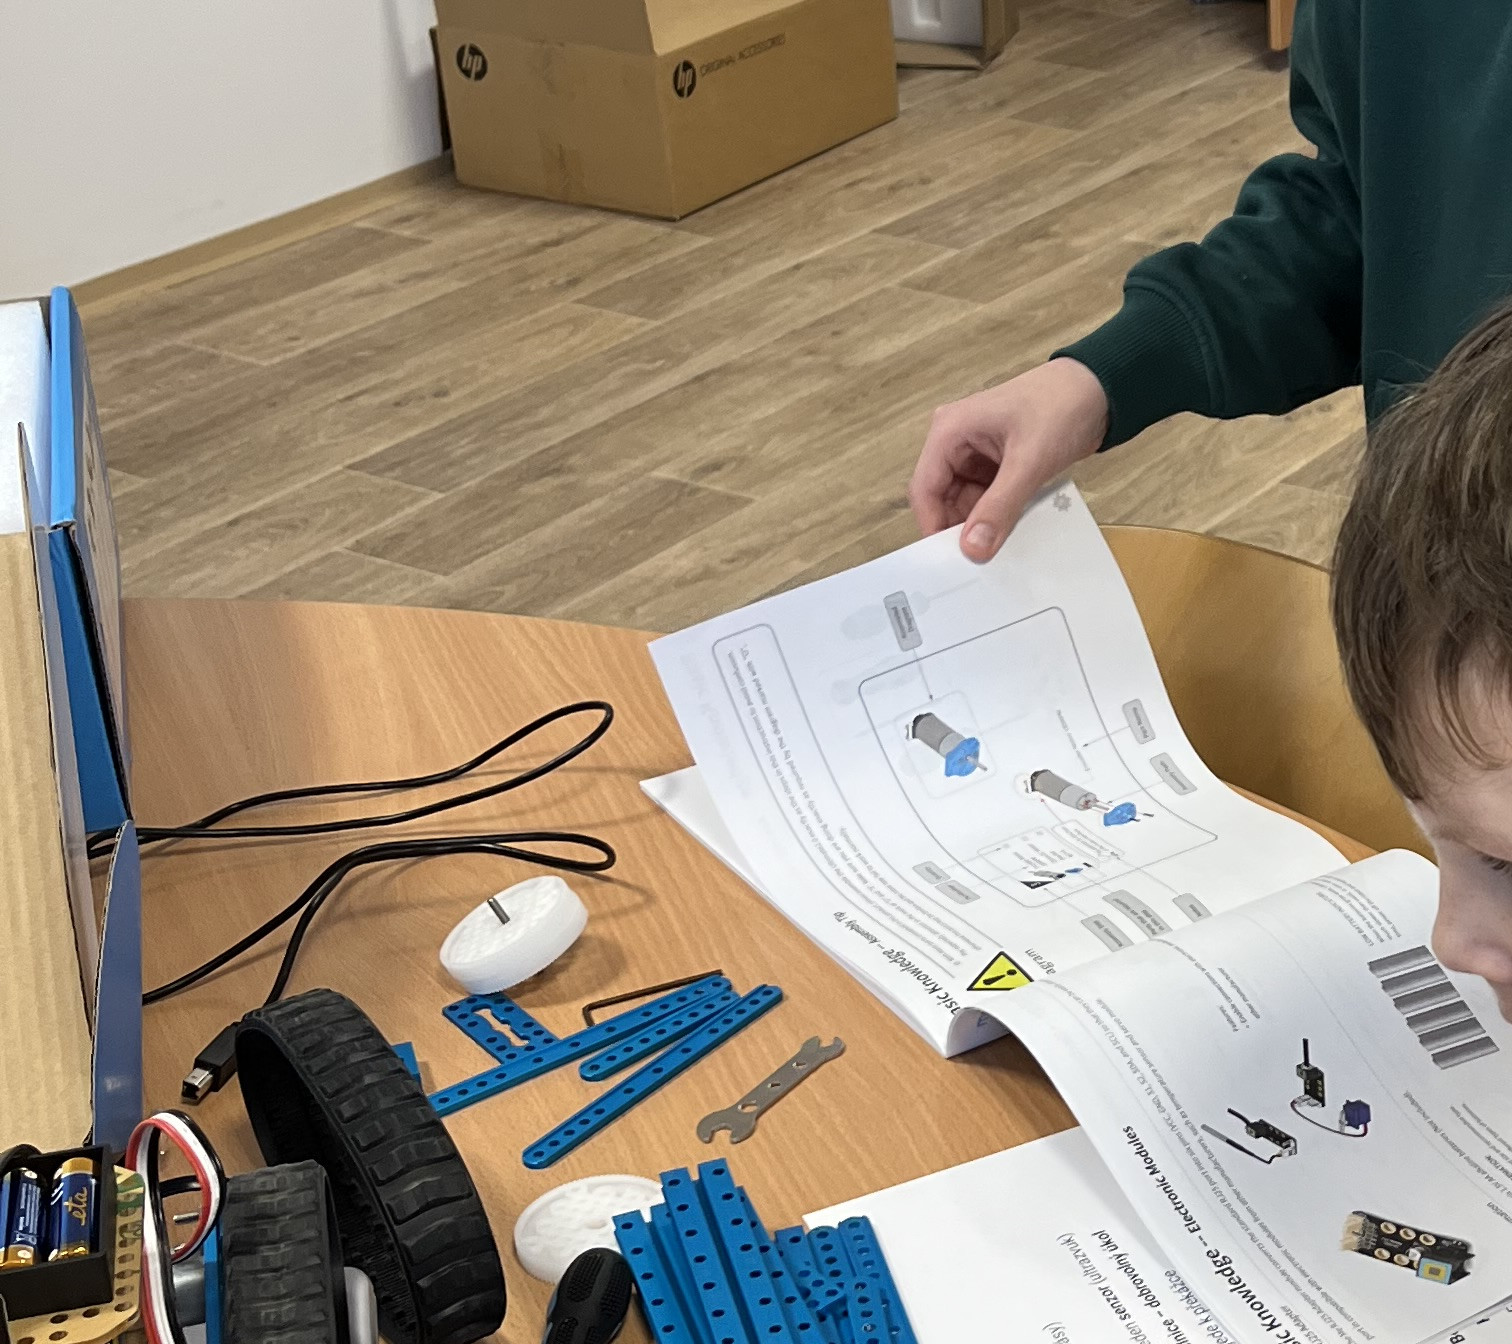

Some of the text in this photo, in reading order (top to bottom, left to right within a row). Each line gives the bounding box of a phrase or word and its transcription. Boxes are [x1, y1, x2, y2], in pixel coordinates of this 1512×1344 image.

[457, 43, 488, 81] hp
[673, 60, 697, 98] hp
[883, 949, 943, 994] Knowledge
[937, 992, 962, 1016] asic
[1123, 1126, 1160, 1175] Modules
[1156, 1175, 1201, 1233] Electronic
[1057, 1233, 1107, 1284] (ultrazvuk)
[1092, 1230, 1118, 1252] úkol
[1109, 1253, 1160, 1307] dobrovolný
[1165, 1270, 1210, 1315] překážce
[1206, 1249, 1281, 1331] Knowledge
[1098, 1286, 1131, 1320] senzor
[1198, 1315, 1213, 1325] k
[1280, 1306, 1309, 1331] Adapter
